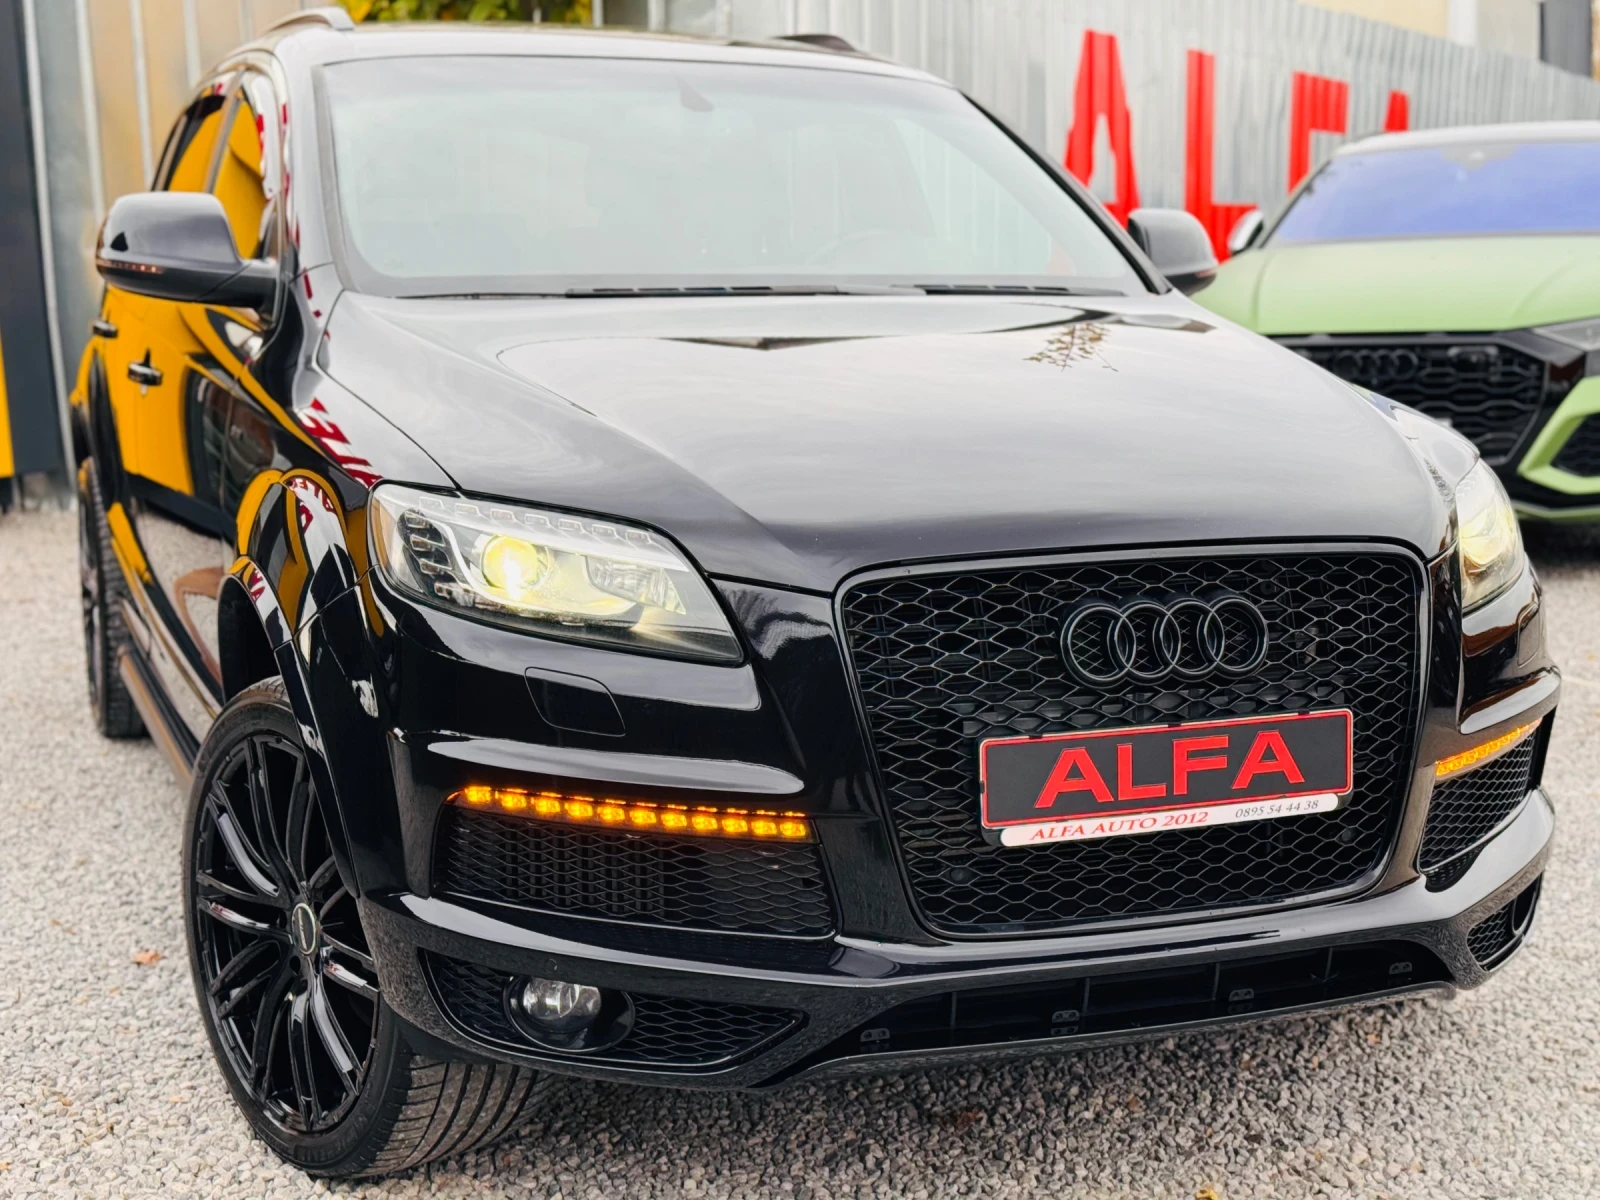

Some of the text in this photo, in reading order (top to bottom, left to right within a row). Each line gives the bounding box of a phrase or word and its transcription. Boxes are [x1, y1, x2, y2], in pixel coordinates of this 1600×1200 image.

[1034, 730, 1305, 808] ALFA
[1030, 800, 1319, 840] ALFA AUTO 2012 0895 54 44 38
